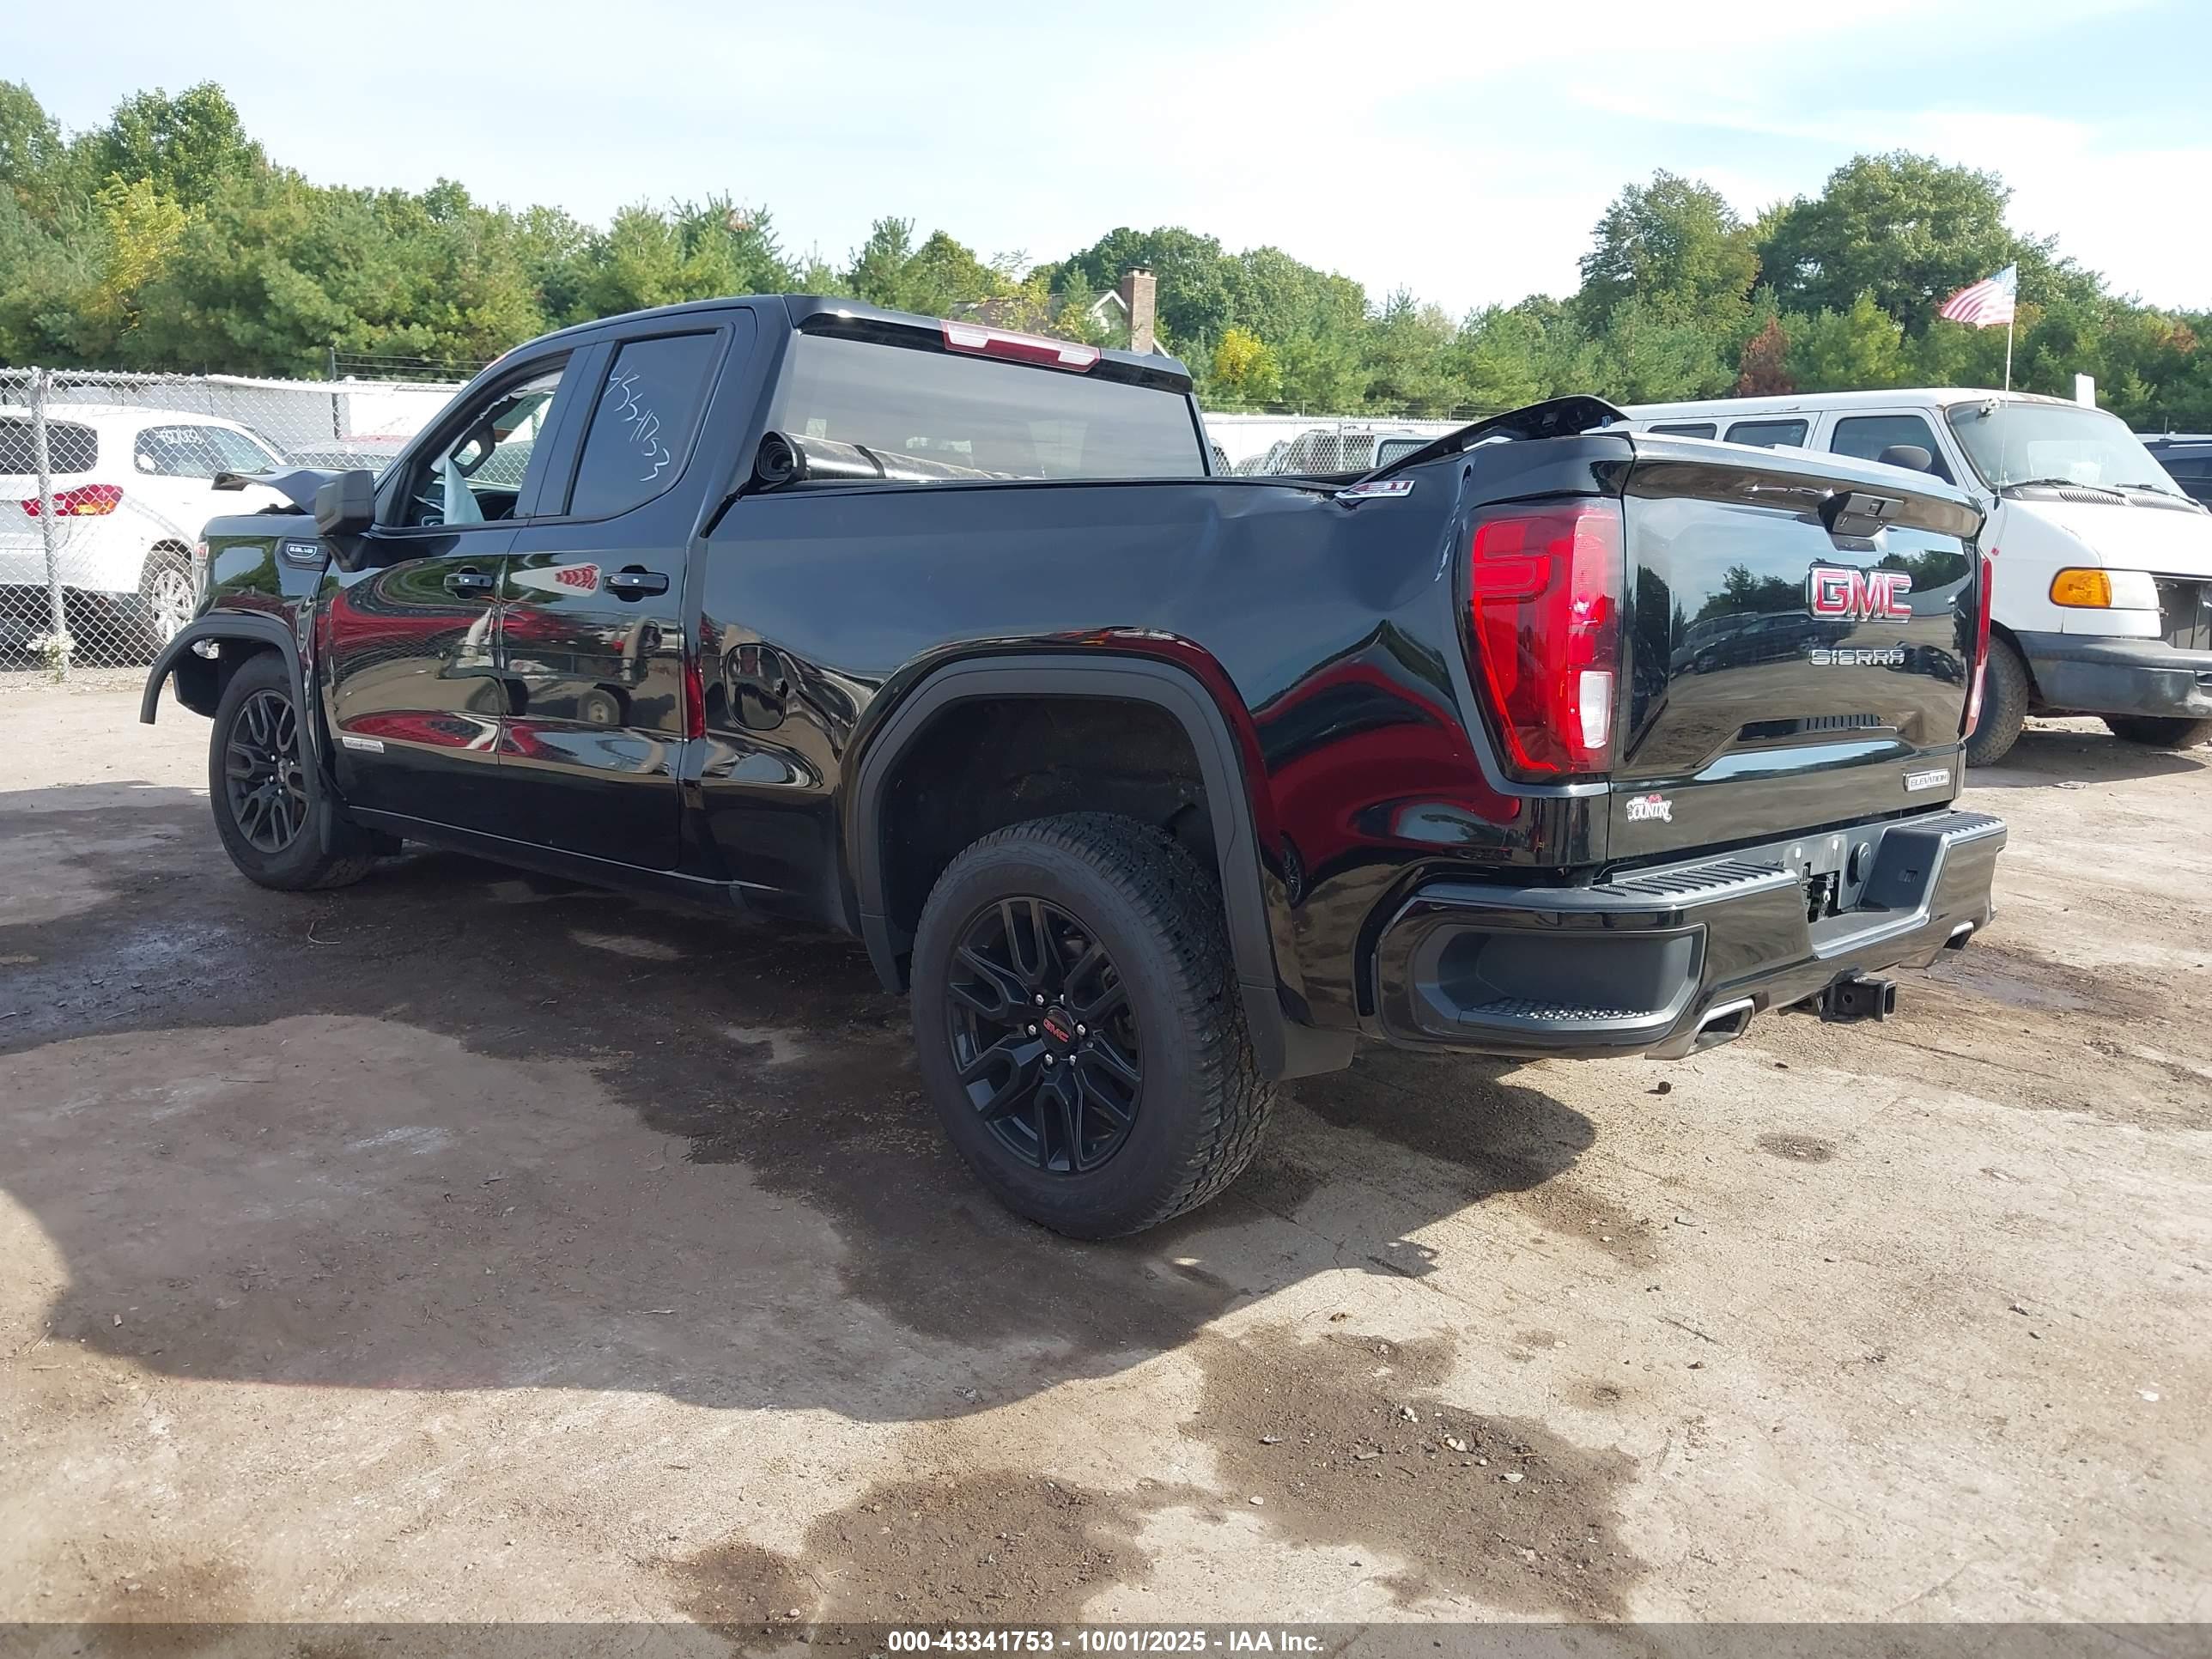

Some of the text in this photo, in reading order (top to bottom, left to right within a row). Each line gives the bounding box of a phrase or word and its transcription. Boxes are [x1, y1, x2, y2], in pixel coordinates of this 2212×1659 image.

[1808, 565, 1912, 621] GMC
[1808, 649, 1905, 665] SIERRA
[1043, 1018, 1069, 1042] GMC
